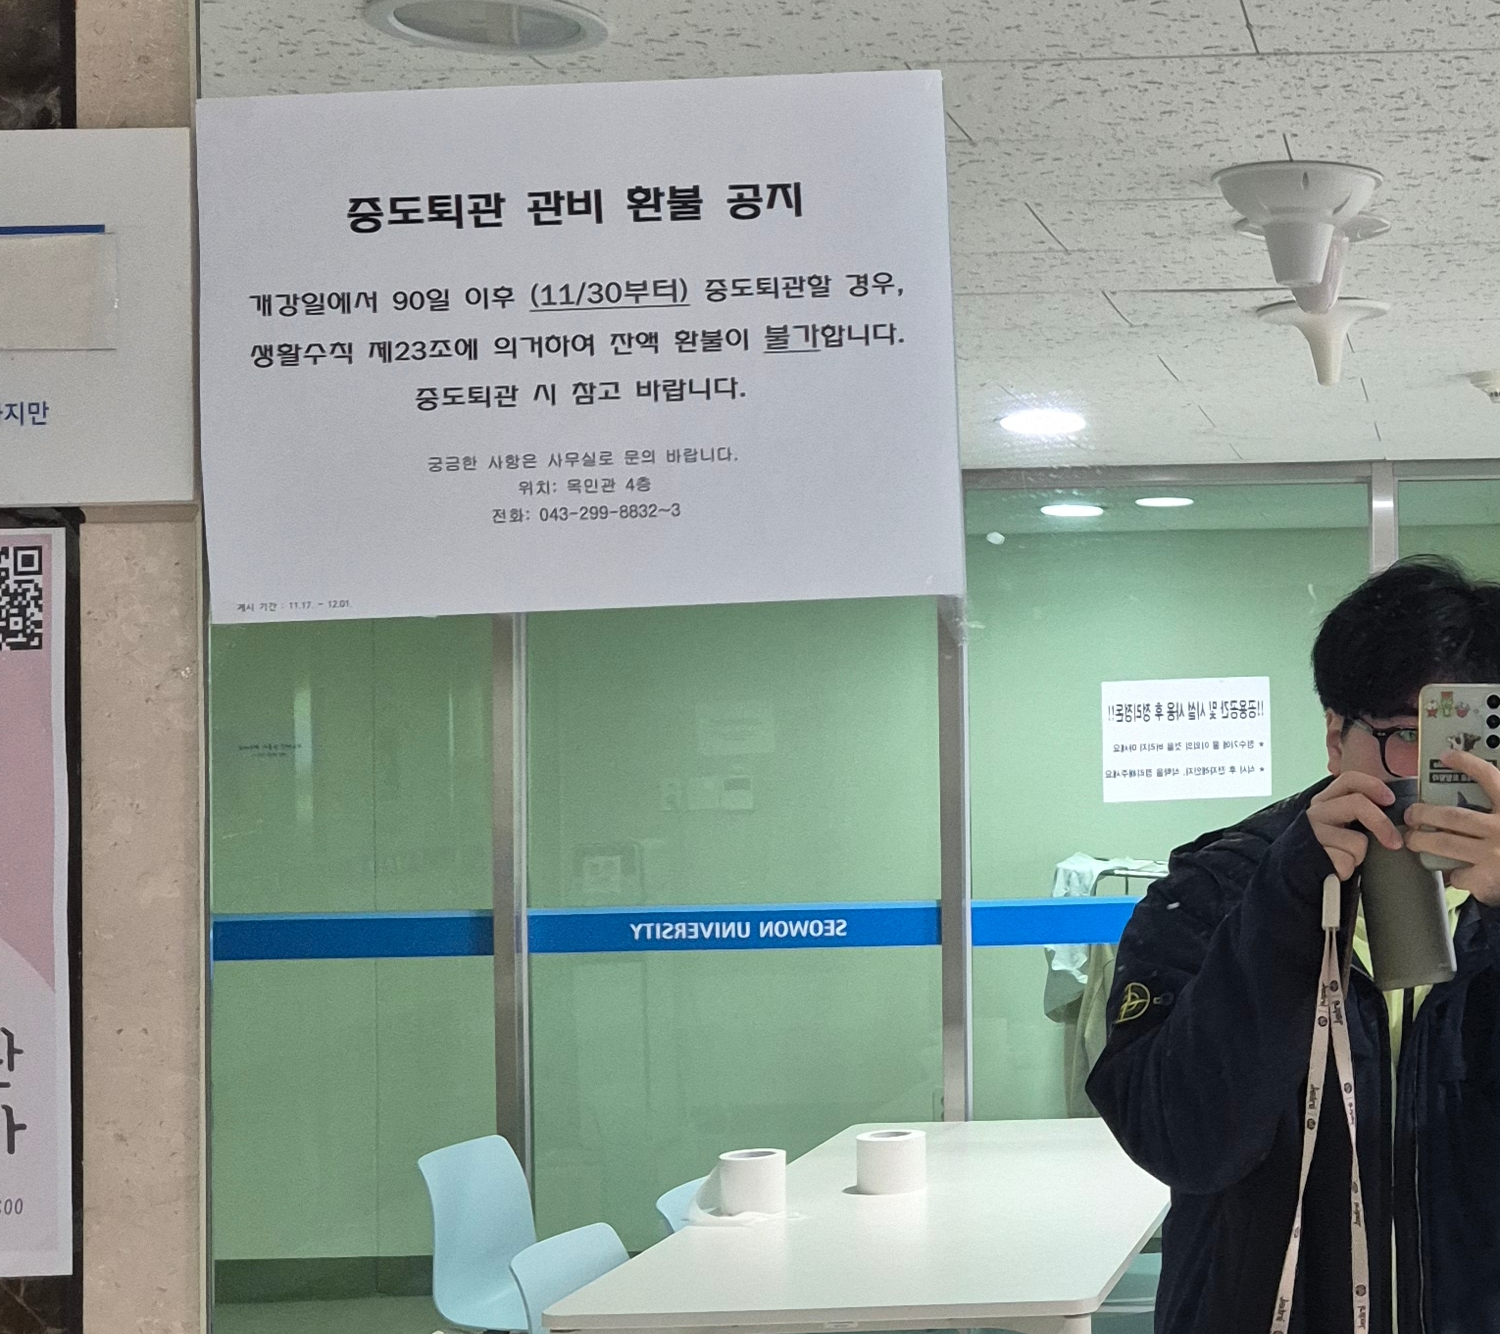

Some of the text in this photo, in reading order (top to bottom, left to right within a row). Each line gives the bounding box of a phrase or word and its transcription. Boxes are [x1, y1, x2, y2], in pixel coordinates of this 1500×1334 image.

[346, 181, 803, 234] 중도퇴관 관비 환불 공지
[248, 271, 904, 318] 개강일에서 90일 이후 (11/30부터) 중도퇴관할 경우,
[250, 322, 905, 369] 생활수칙 제23조에 의거하여 잔액 환불이 불가합니다.
[415, 376, 746, 412] 중도퇴관 시 참고 바랍니다.
[0, 400, 50, 427] 지만
[427, 446, 739, 473] 궁금한 사항은 사무실로 문의 바랍니다.
[518, 480, 557, 497] 위치:
[625, 476, 652, 493] 4층
[492, 502, 681, 524] 전화: 043-299-8832~3
[0, 1197, 24, 1216] :00
